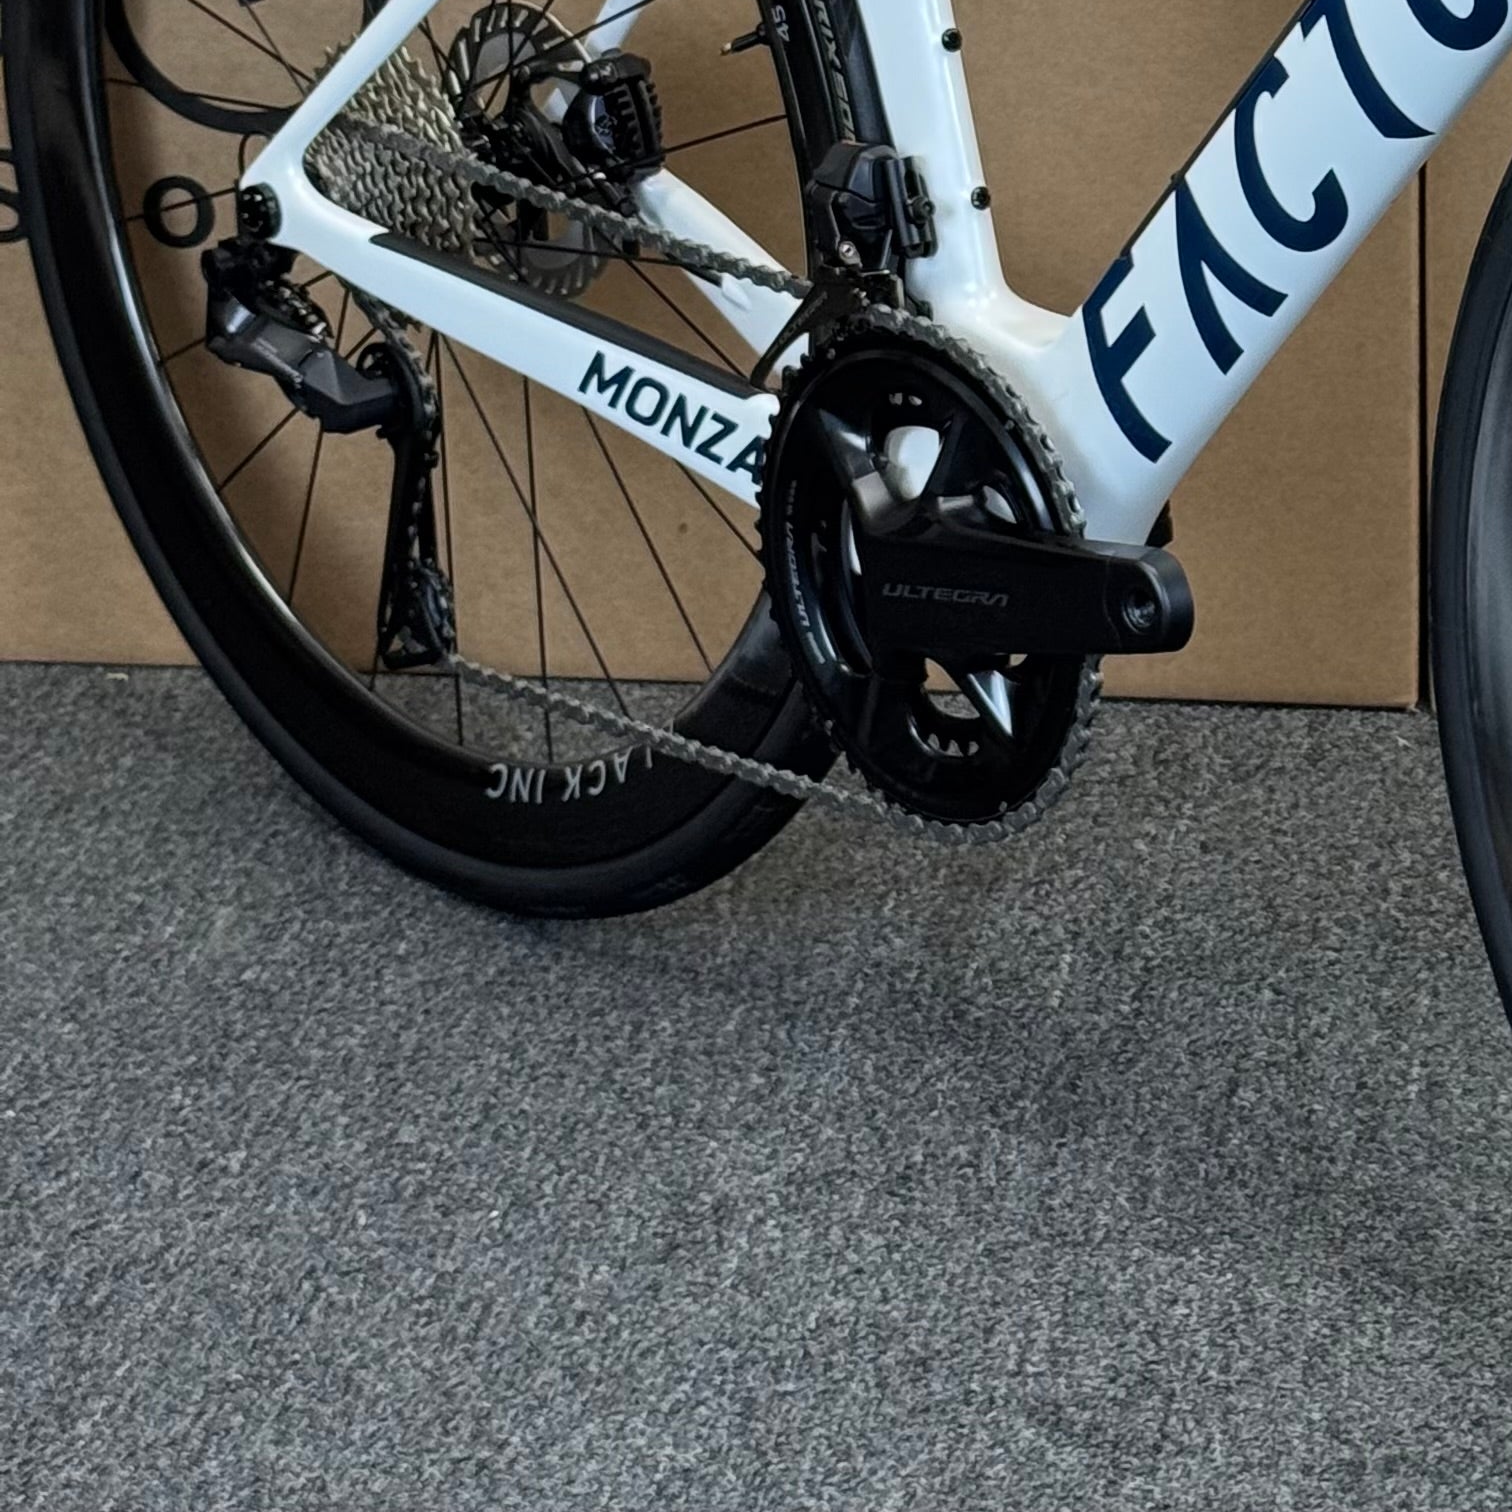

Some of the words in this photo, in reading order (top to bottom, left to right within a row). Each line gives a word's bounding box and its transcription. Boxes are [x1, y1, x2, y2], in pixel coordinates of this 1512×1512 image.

[578, 350, 766, 486] MONZA
[882, 582, 1010, 607] ULTEGRA
[485, 762, 547, 804] INC
